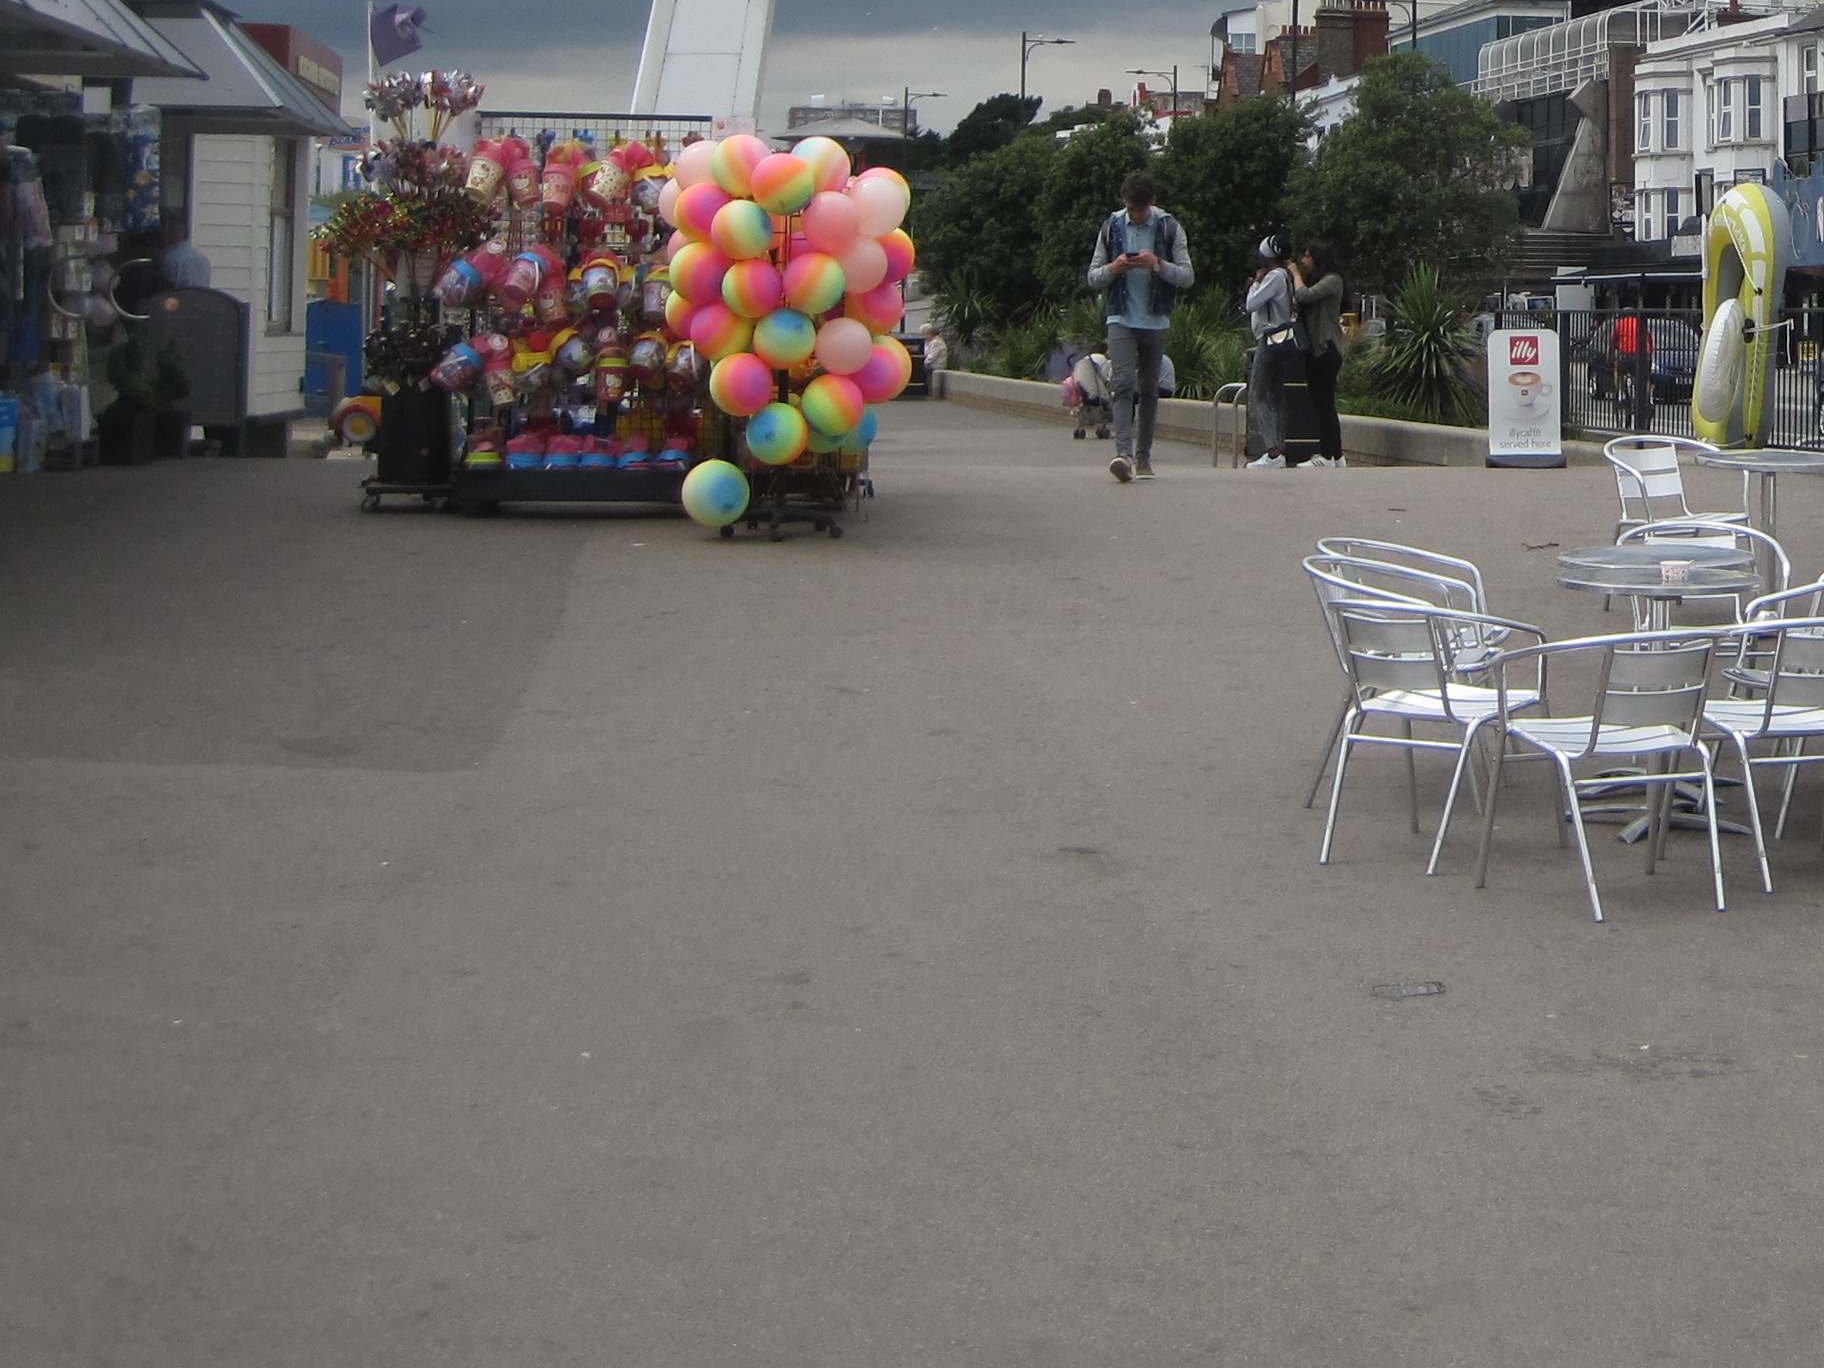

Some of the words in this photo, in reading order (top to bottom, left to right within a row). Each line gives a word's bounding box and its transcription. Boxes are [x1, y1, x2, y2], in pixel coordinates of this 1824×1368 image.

[1511, 340, 1537, 363] illy
[1499, 438, 1529, 448] served
[1531, 438, 1552, 448] here
